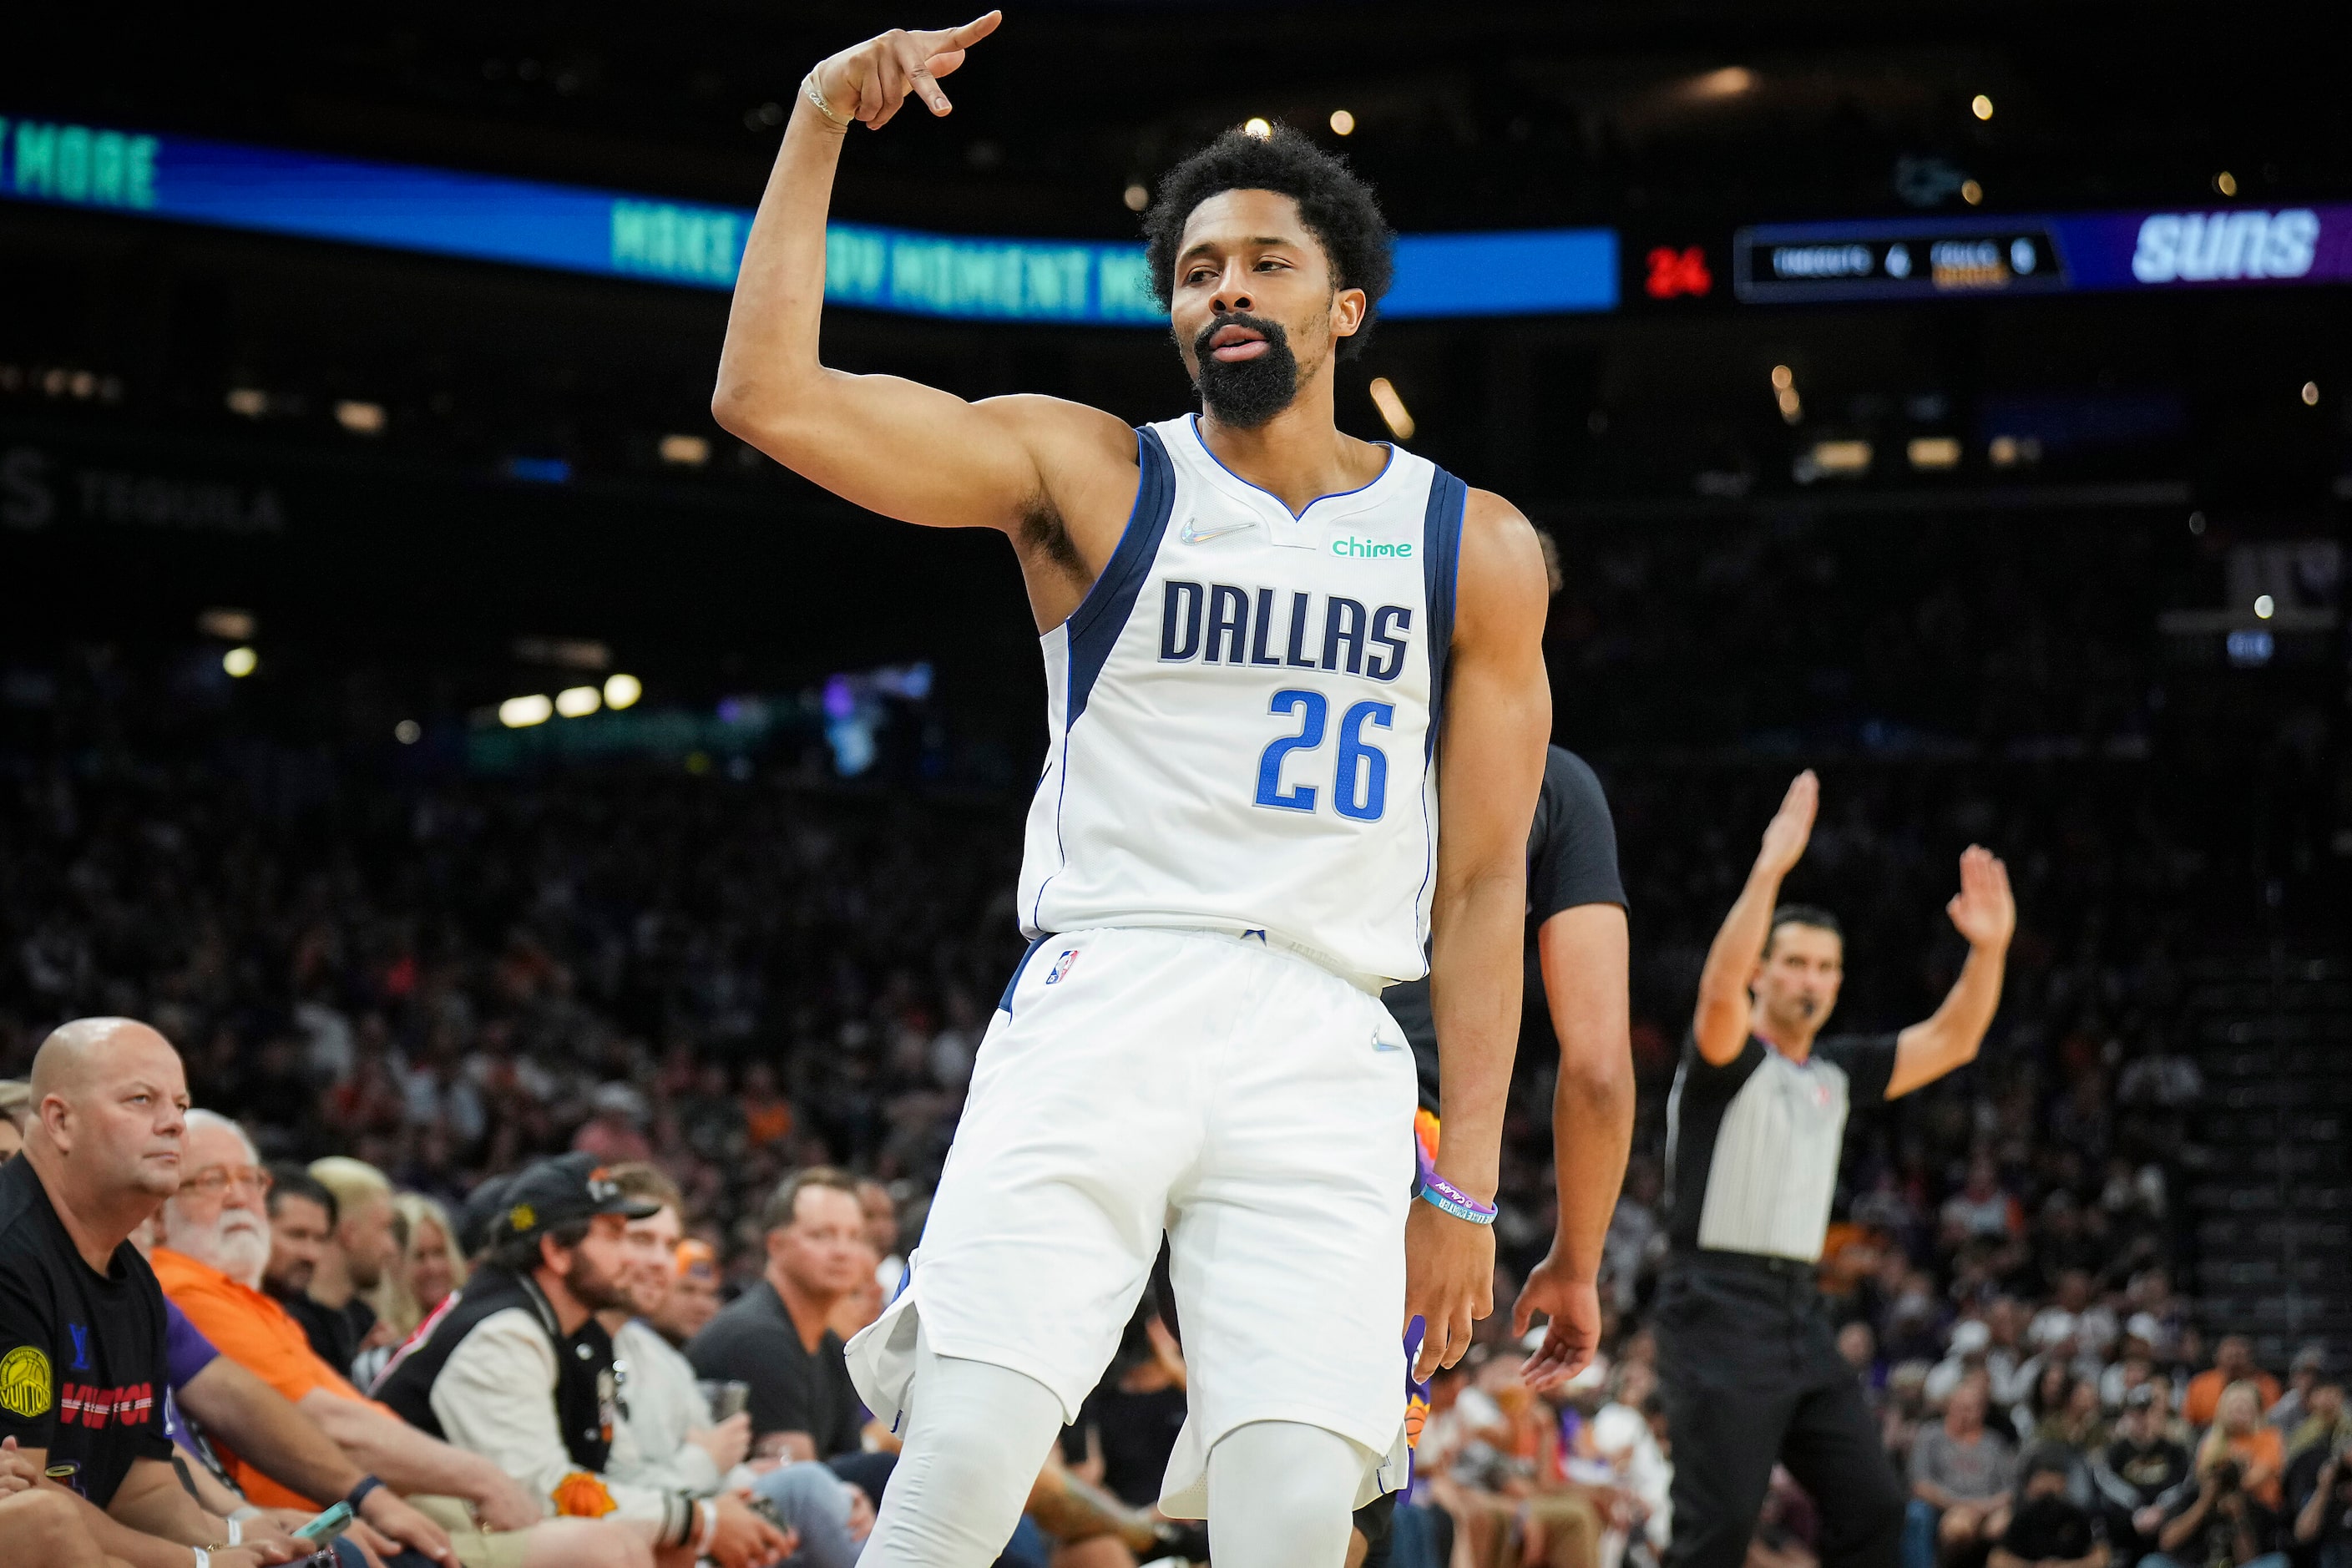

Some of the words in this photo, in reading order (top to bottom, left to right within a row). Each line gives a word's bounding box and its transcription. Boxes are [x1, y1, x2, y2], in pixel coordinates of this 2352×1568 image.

[15, 121, 159, 210] MORE
[892, 240, 1085, 317] MOMENT
[1646, 245, 1712, 298] 24
[2132, 209, 2320, 284] SUNS
[1332, 535, 1412, 559] chime
[1158, 578, 1414, 684] DALLAS
[1252, 688, 1396, 823] 26
[1439, 1197, 1468, 1219] WATER
[1467, 1211, 1485, 1224] LIKE
[1, 1378, 48, 1414] VUITTON
